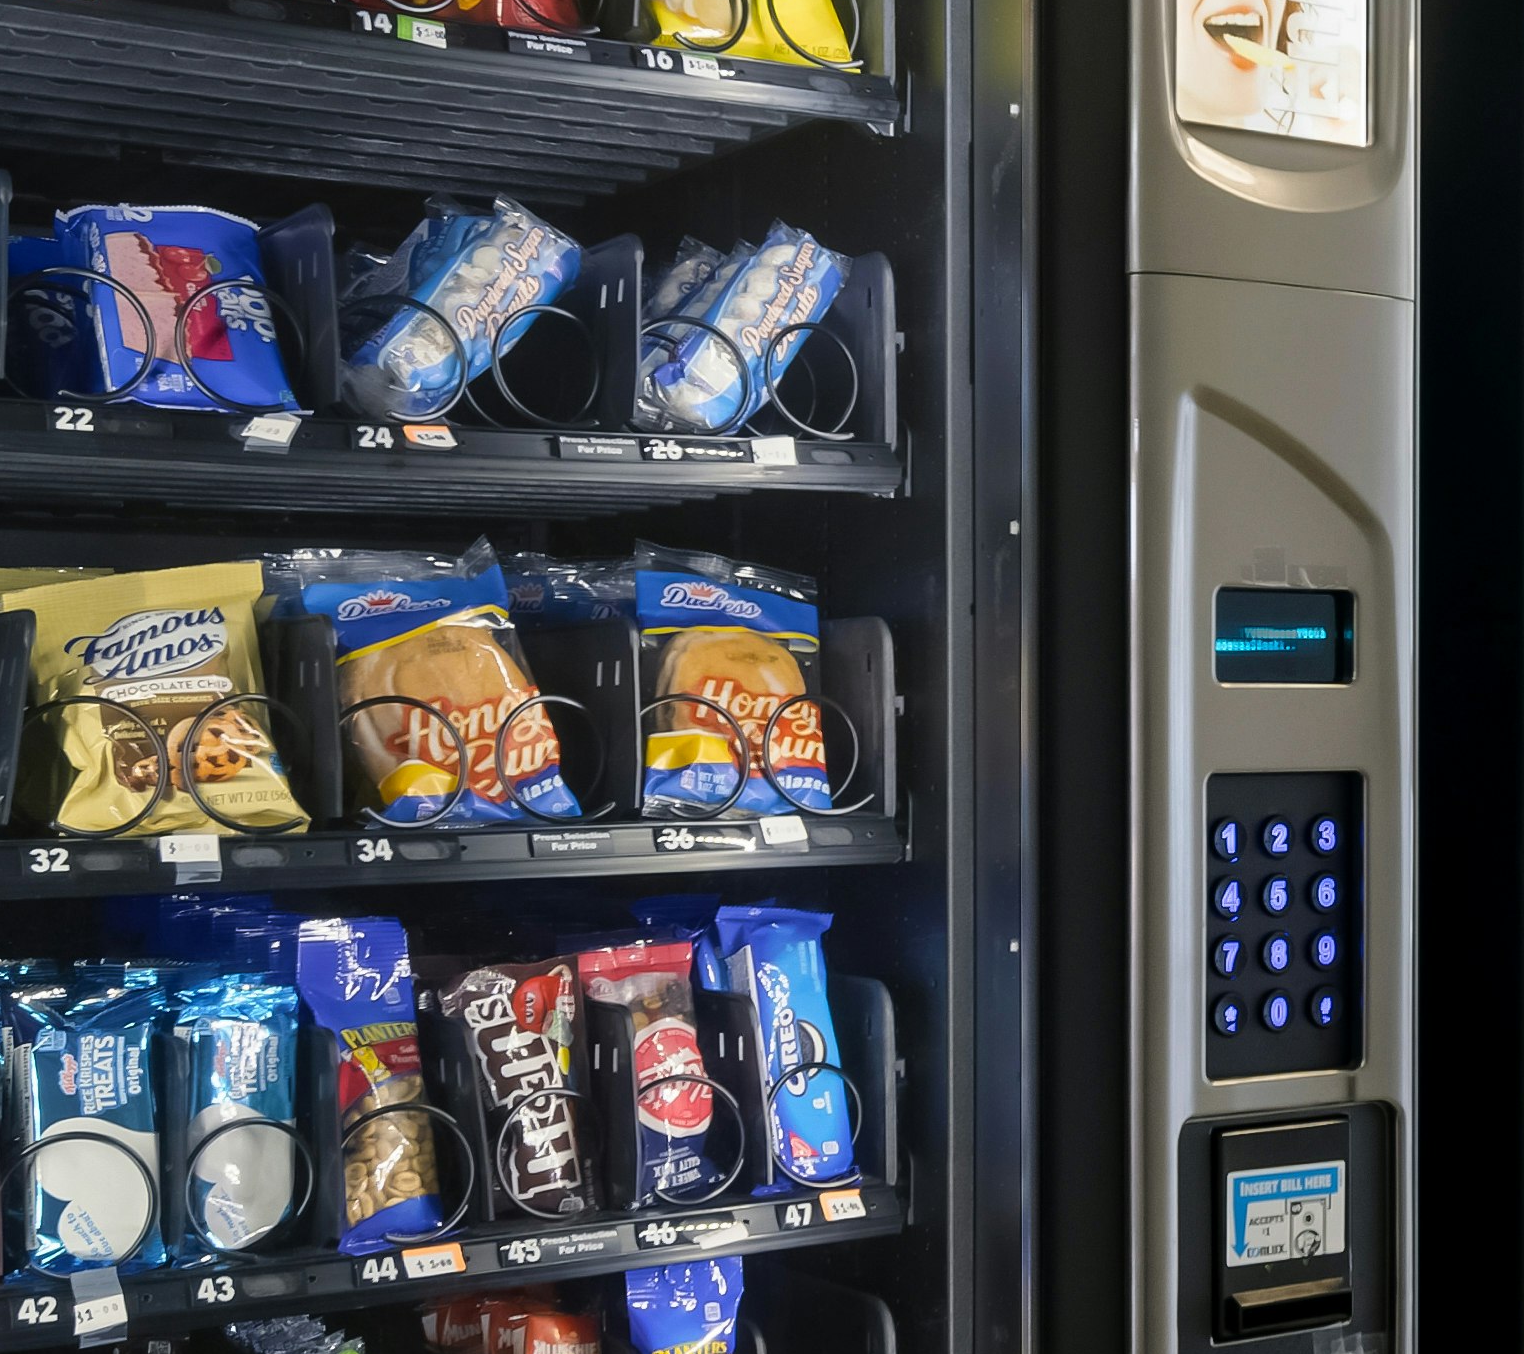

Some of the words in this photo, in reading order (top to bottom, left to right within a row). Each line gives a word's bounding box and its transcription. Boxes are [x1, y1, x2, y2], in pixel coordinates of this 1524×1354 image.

[356, 10, 393, 34] 14
[640, 49, 674, 71] 16
[53, 407, 94, 432] 22
[357, 425, 395, 450] 24
[662, 585, 762, 618] Duchess
[64, 606, 226, 666] Famous
[83, 633, 225, 685] Amos
[106, 679, 194, 700] CHOCOLATE
[197, 678, 229, 691] CHIP
[696, 679, 823, 736] Honey
[206, 792, 227, 806] NET
[228, 791, 245, 805] WT
[246, 791, 253, 803] 2
[254, 790, 269, 803] OZ
[357, 839, 394, 863] 34
[1221, 822, 1237, 854] 1
[1271, 823, 1288, 853] 2
[1318, 820, 1336, 851] 3
[29, 847, 70, 873] 32
[1221, 881, 1241, 914] 4
[1269, 880, 1287, 911] 5
[1317, 877, 1336, 907] 6
[1223, 942, 1239, 973] 7
[1270, 939, 1288, 970] 8
[1318, 935, 1336, 966] 9
[1270, 997, 1289, 1028] 0
[80, 1034, 96, 1089] KRISPIES
[267, 1035, 280, 1083] Original
[779, 1006, 808, 1098] OREO
[96, 1034, 115, 1112] TREATS
[127, 1045, 144, 1095] Original
[83, 1089, 98, 1115] RICE
[1239, 1178, 1279, 1198] INSERT
[1280, 1176, 1303, 1193] BILL
[1304, 1174, 1332, 1190] HERE
[785, 1202, 813, 1227] 47
[362, 1257, 399, 1283] 44
[197, 1275, 236, 1302] 43
[17, 1296, 59, 1324] 42
